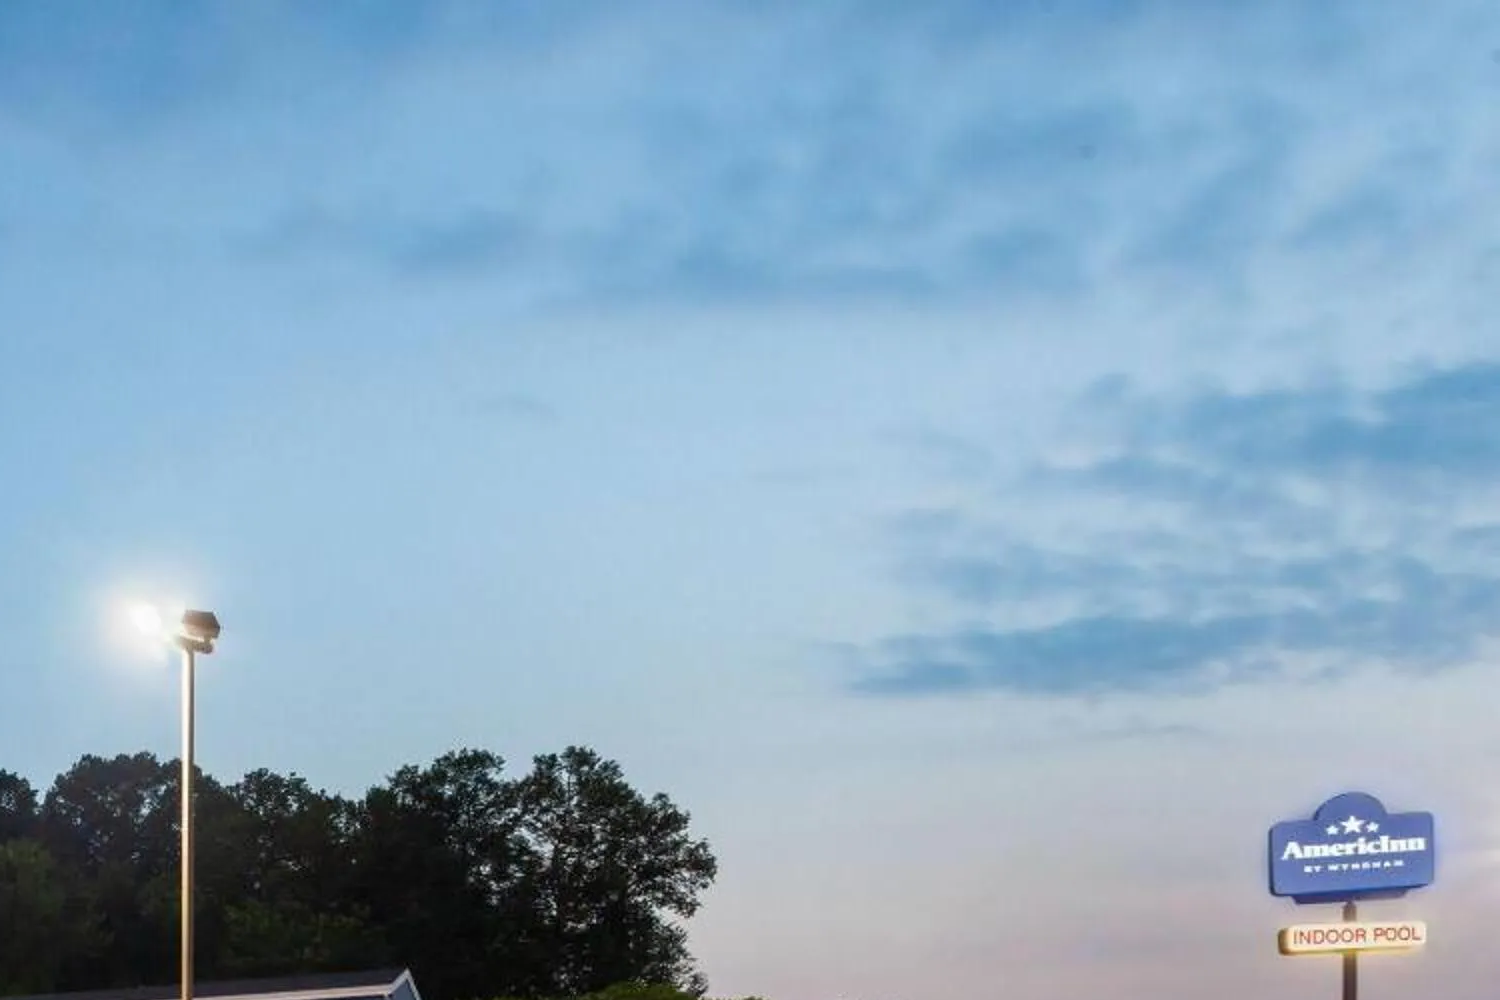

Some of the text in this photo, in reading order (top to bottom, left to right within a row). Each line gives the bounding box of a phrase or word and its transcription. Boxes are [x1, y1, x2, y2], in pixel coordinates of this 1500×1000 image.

[1281, 835, 1427, 860] AmericInn
[1303, 865, 1322, 873] BY
[1293, 926, 1422, 945] INDOOR POOL
